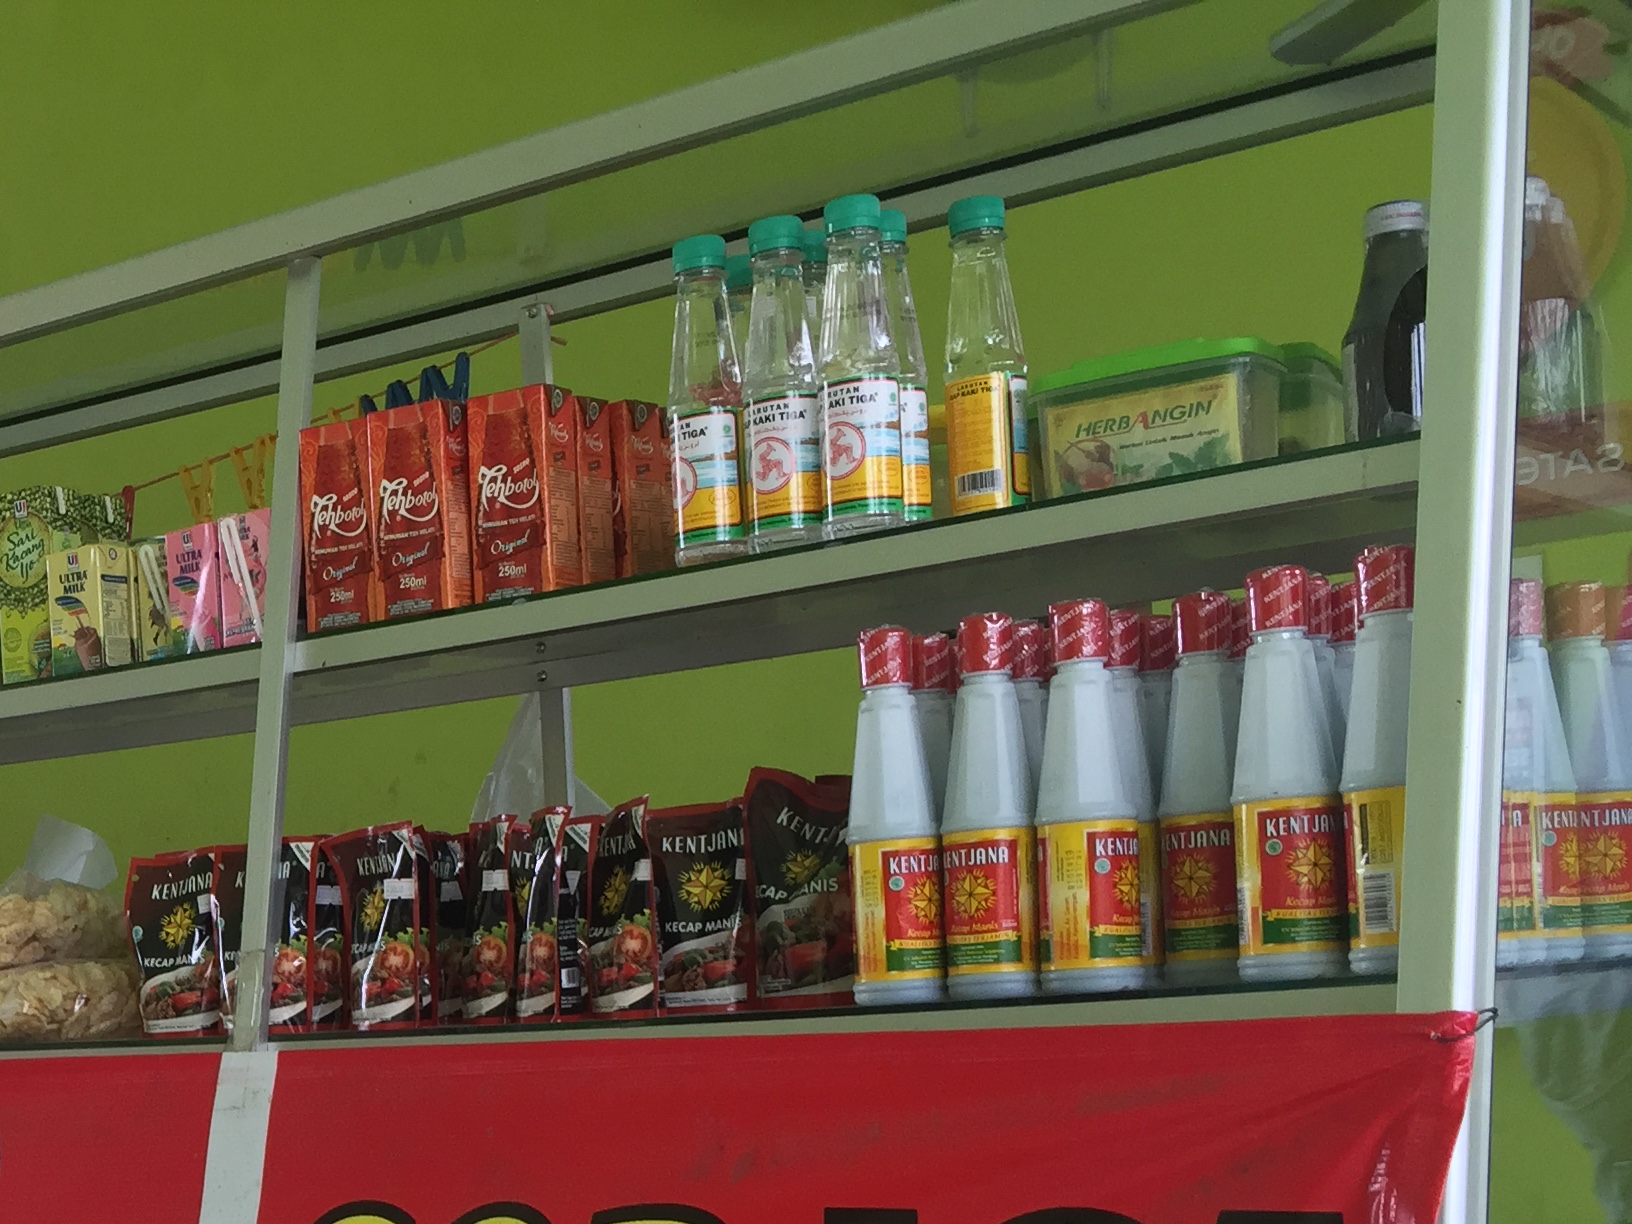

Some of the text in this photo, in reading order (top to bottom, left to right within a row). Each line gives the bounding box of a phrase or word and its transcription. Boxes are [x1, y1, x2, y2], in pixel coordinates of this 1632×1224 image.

[849, 393, 877, 405] TIGA
[780, 410, 805, 421] TIGA
[1075, 399, 1213, 438] HERBANGIN
[681, 427, 706, 441] TIGA
[490, 528, 531, 555] Original
[176, 549, 202, 564] ULTRA
[392, 541, 431, 567] Original
[179, 562, 200, 575] MILK
[498, 563, 527, 578] 250ml
[59, 570, 88, 585] ULTRA
[399, 576, 427, 589] 250ml
[63, 581, 86, 595] MILK
[151, 871, 213, 900] KENTJANA
[665, 917, 743, 933] KECAP MANIS
[143, 956, 175, 968] KECAP
